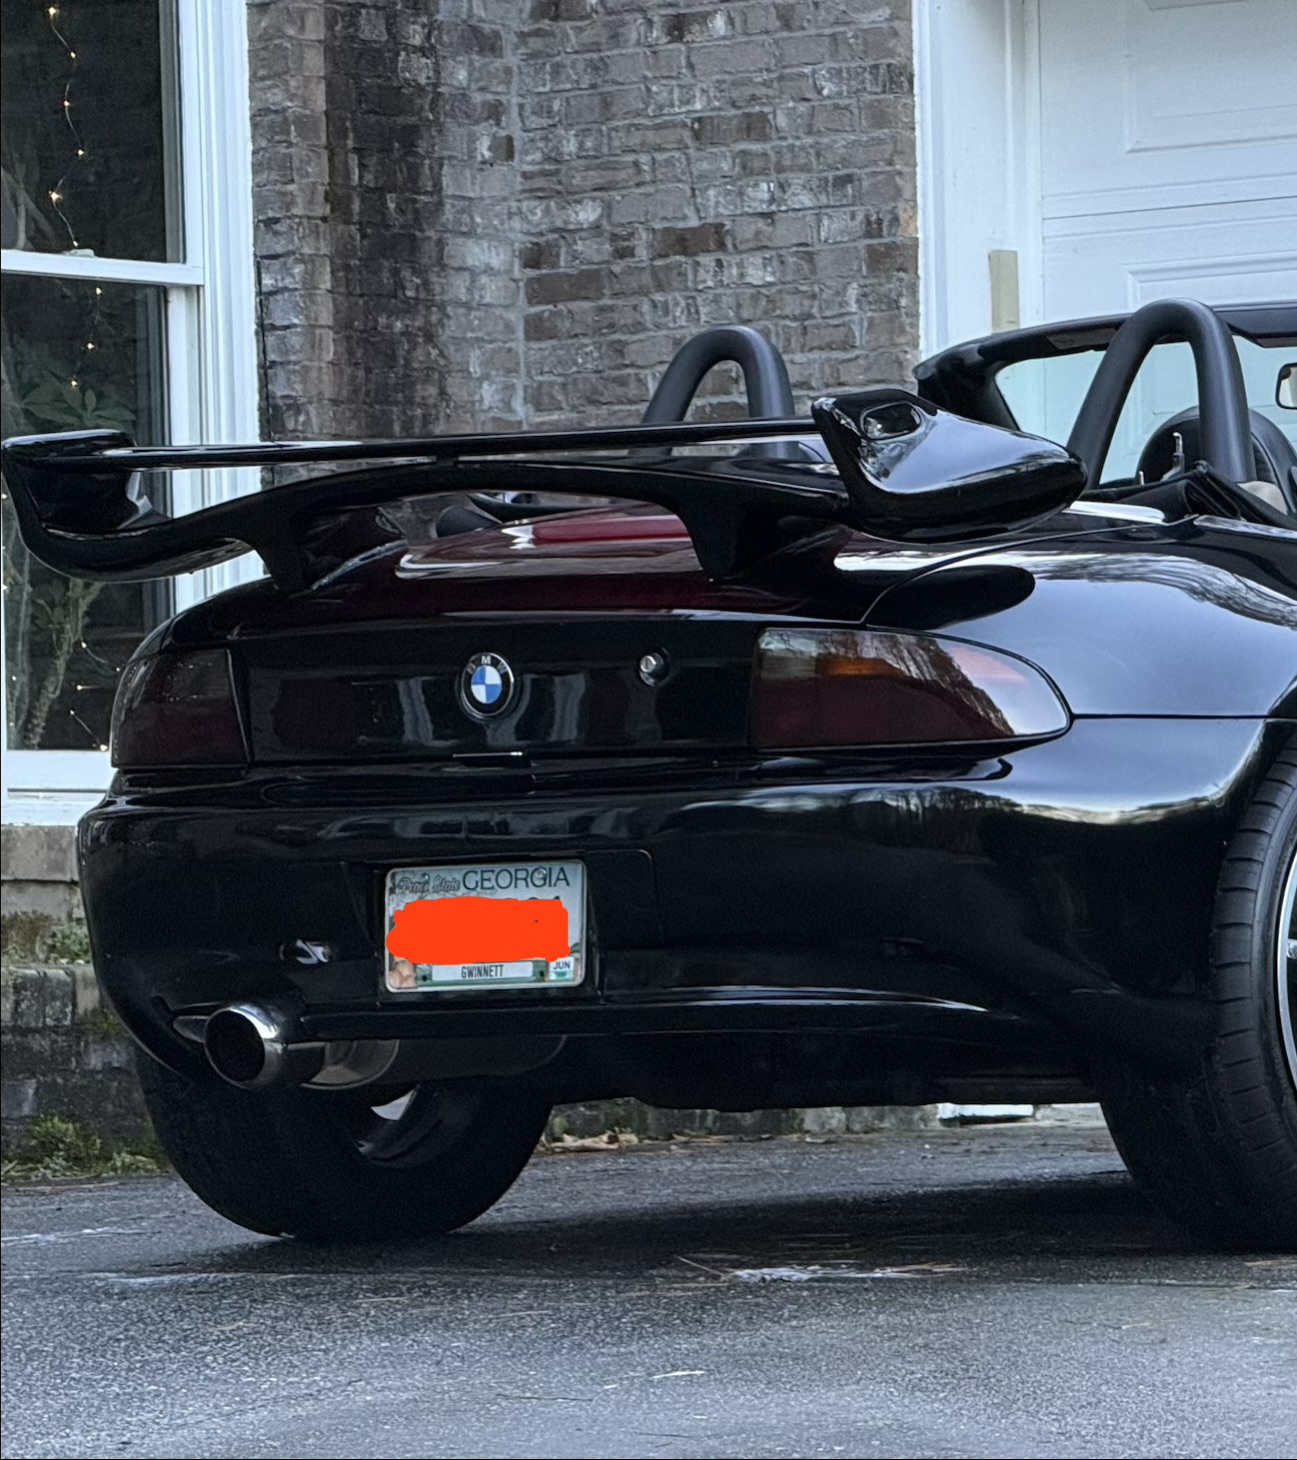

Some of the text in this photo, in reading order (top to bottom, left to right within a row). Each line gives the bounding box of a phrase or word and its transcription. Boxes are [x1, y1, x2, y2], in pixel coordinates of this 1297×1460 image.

[467, 655, 509, 674] BMW
[462, 867, 571, 891] GEORGIA
[461, 964, 504, 979] GWINNETT
[553, 961, 571, 970] JUN
